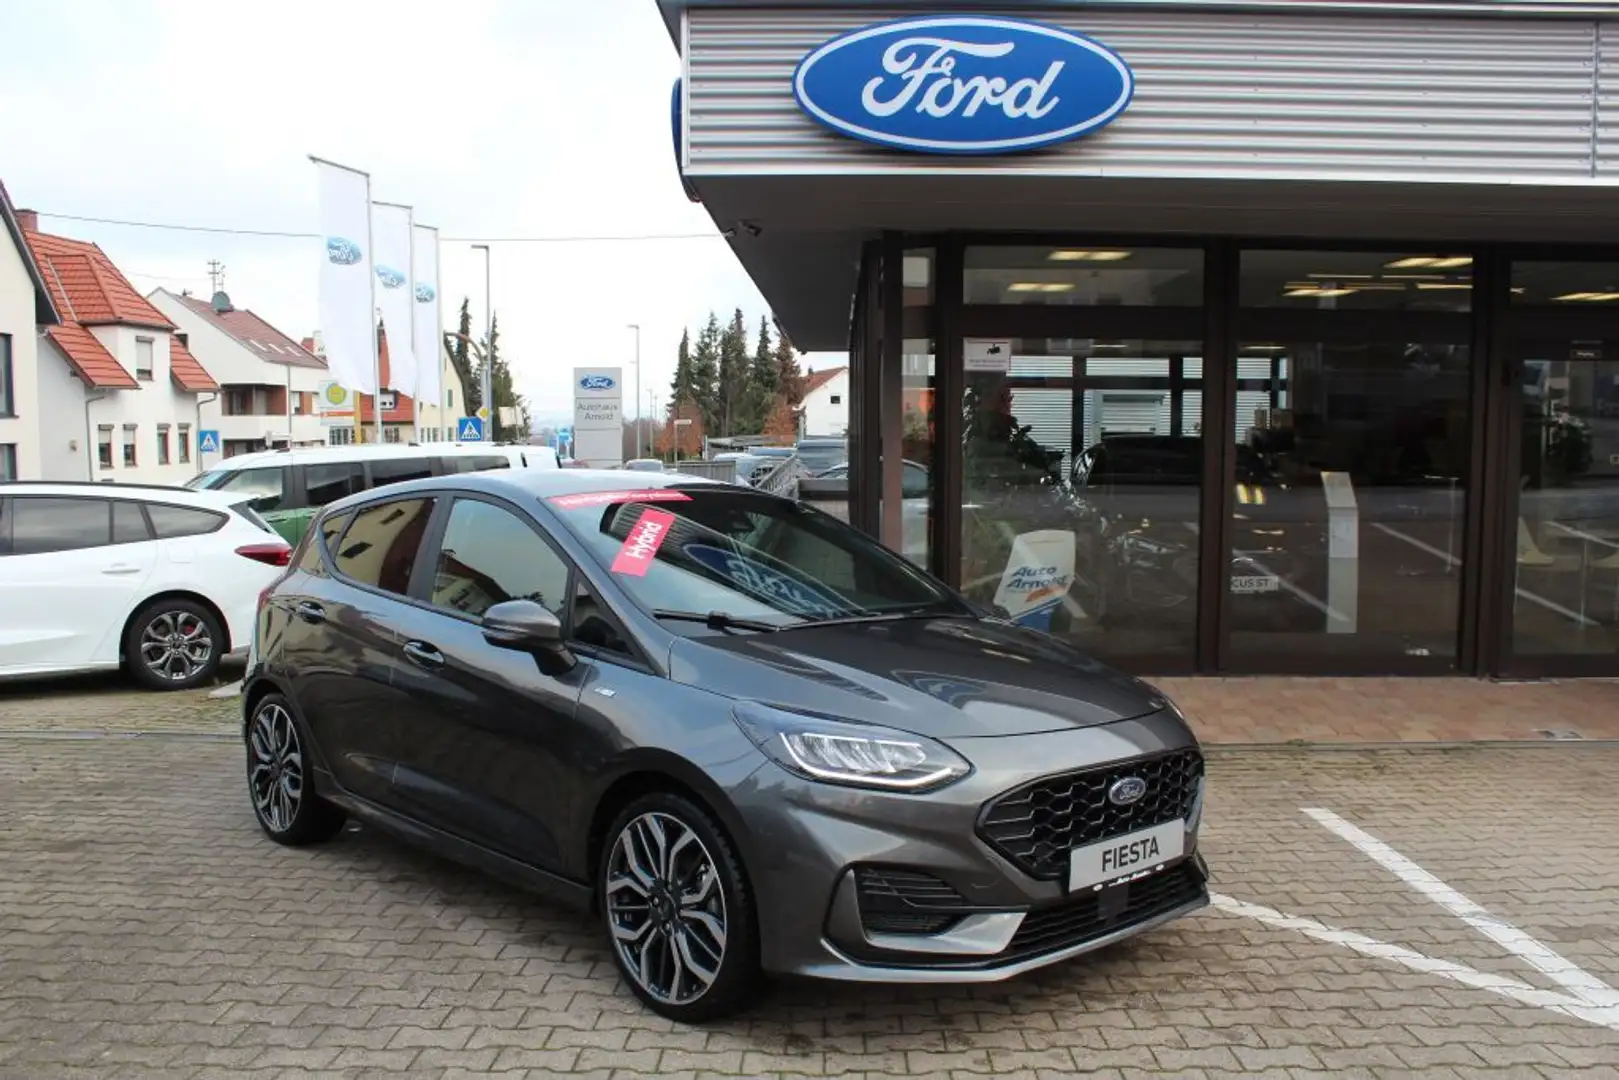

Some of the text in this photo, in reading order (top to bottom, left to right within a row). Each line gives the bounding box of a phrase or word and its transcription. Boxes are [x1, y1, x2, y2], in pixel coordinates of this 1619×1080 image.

[862, 37, 1065, 119] Ford
[577, 402, 618, 411] Autohaus
[584, 412, 614, 421] Arnold
[624, 520, 662, 560] Hybrid
[1101, 836, 1160, 873] FIESTA
